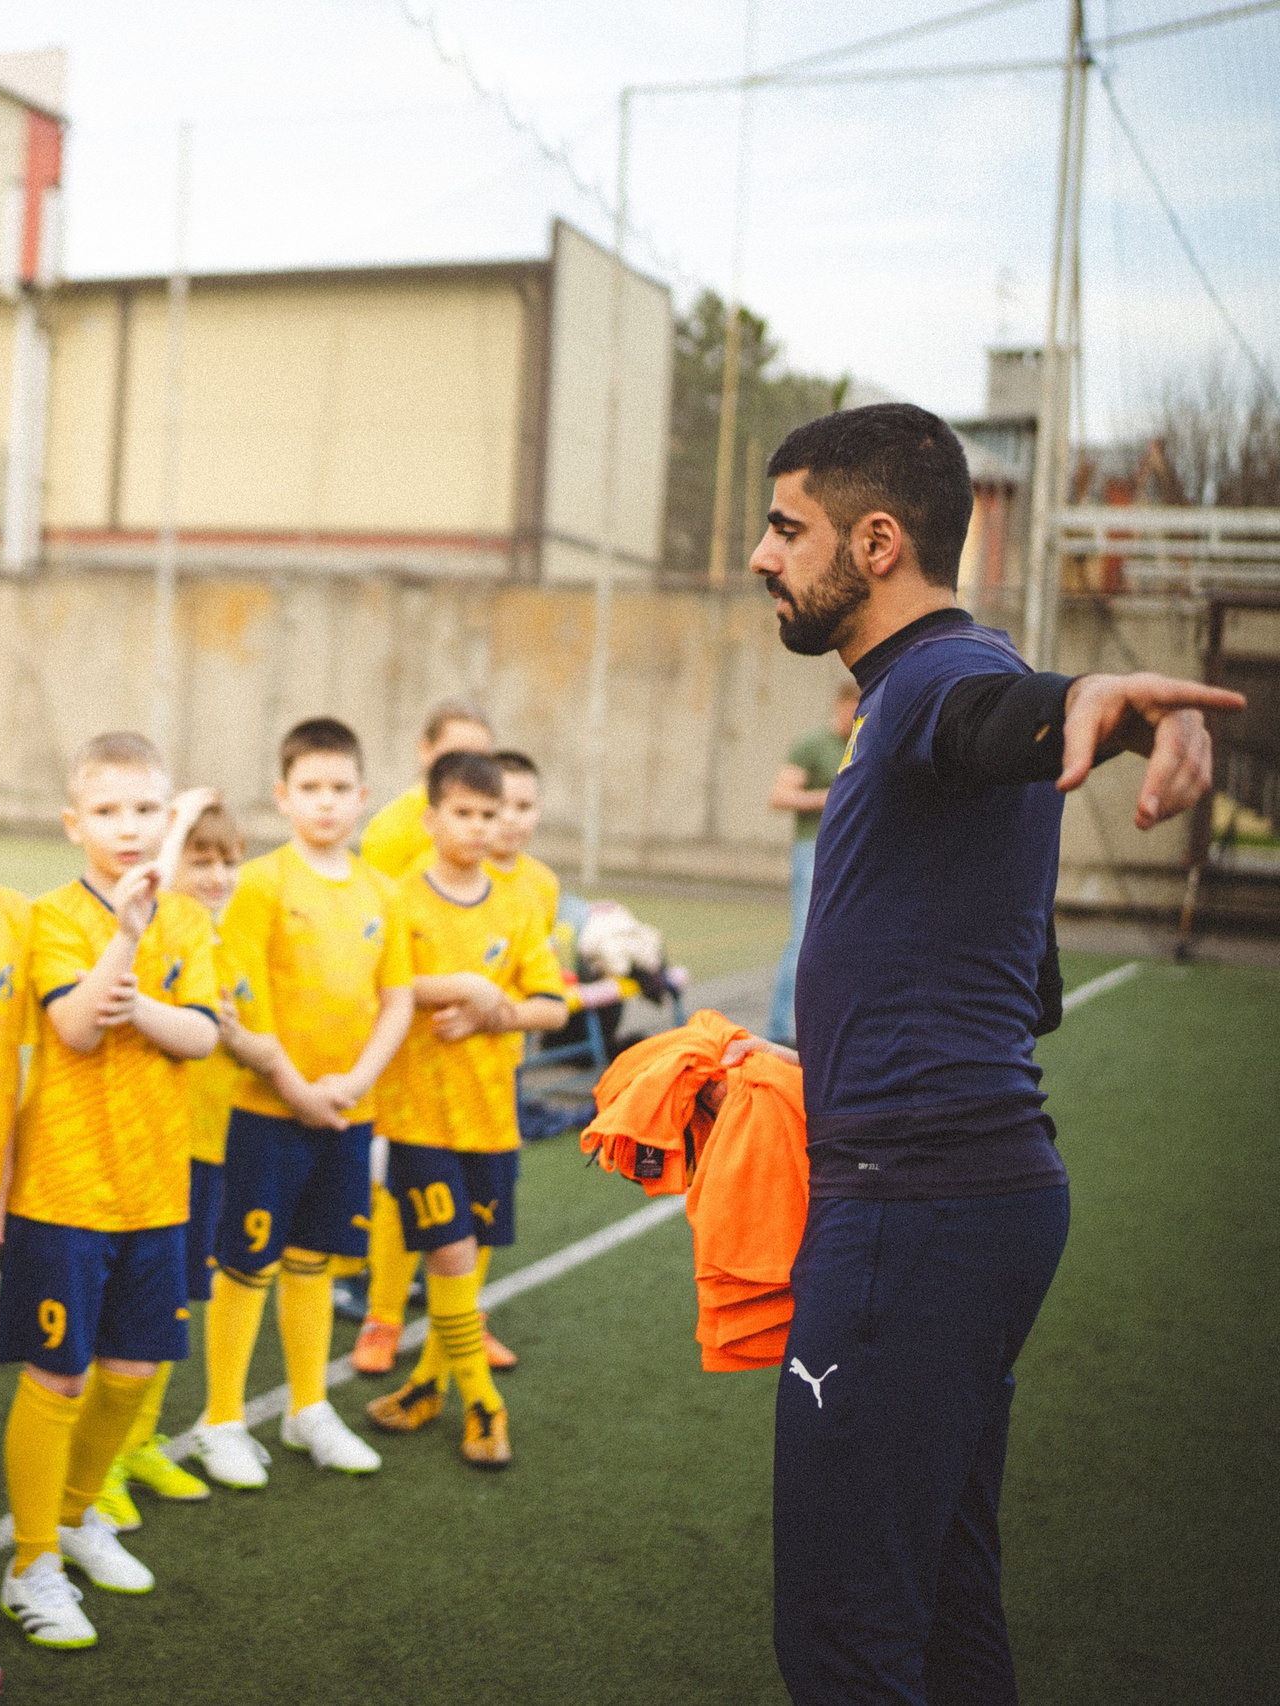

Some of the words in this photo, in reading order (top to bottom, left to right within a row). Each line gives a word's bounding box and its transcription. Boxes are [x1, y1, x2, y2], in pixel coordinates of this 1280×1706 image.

[407, 1181, 455, 1230] 10
[243, 1208, 272, 1254] 9
[38, 1298, 67, 1350] 9
